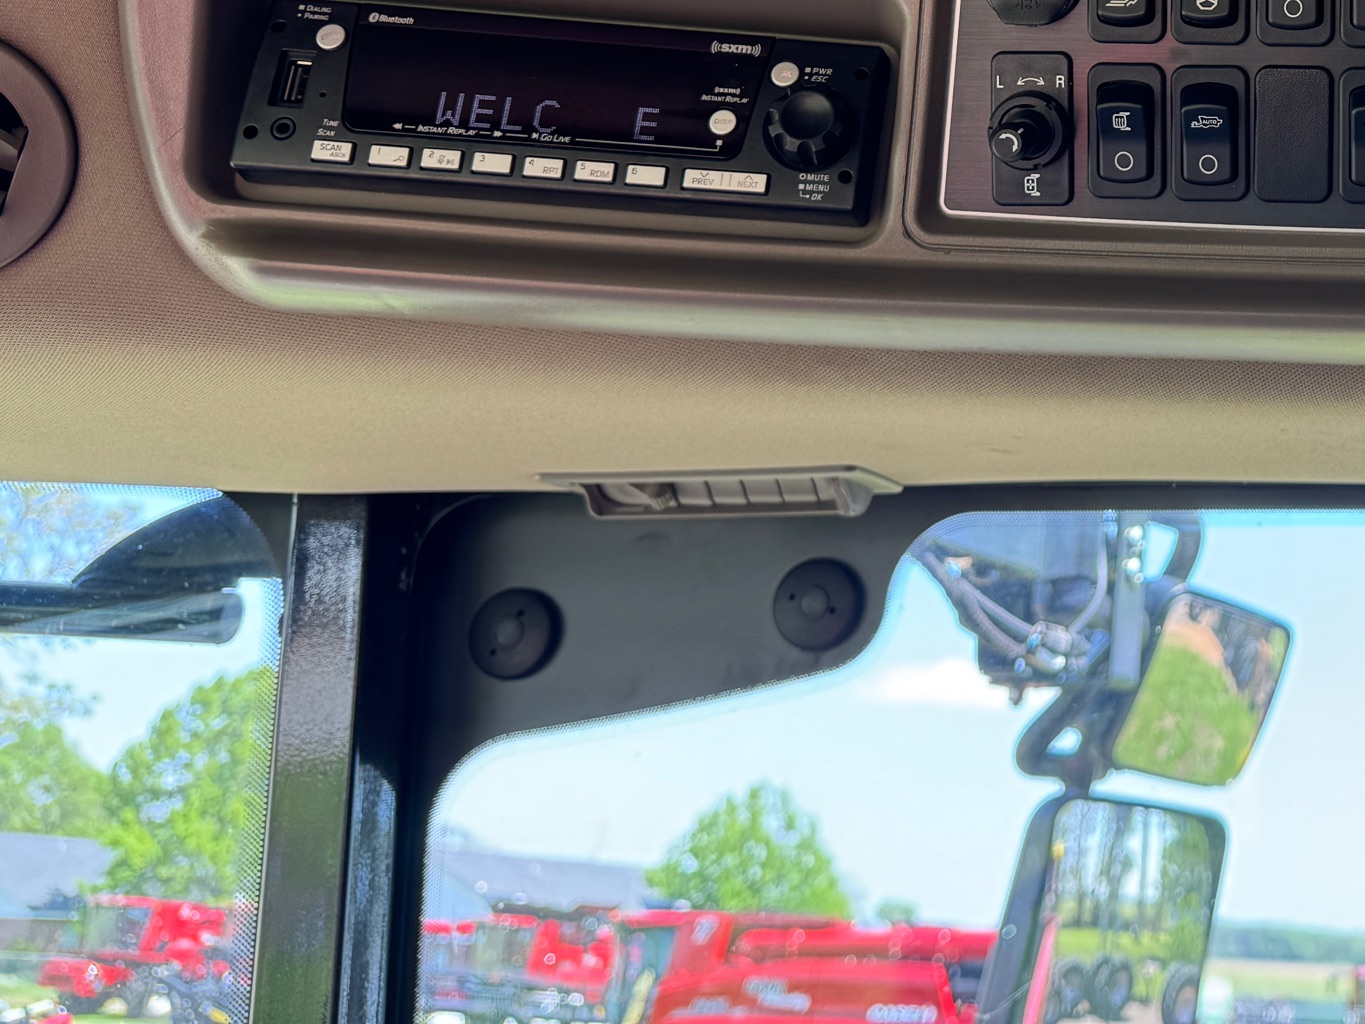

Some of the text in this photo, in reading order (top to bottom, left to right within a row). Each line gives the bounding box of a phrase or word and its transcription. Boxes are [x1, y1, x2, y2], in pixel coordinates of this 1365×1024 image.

[306, 5, 332, 13] DIALING
[304, 13, 329, 21] PAIRING
[379, 14, 414, 24] Bluetooth
[812, 67, 833, 75] PWR
[811, 75, 828, 83] ESC
[996, 74, 1004, 88] L
[1056, 75, 1065, 88] R
[701, 94, 749, 104] INSTANT REPLAY
[435, 91, 660, 141] WELC E
[323, 119, 339, 127] TUNE
[317, 128, 336, 136] SCAN
[416, 124, 478, 136] INSTANT REPLAY
[553, 135, 571, 143] LIVE
[320, 143, 342, 151] SCAN
[543, 167, 559, 175] RPT
[590, 169, 610, 178] RDM
[807, 173, 829, 181] MUTE
[692, 177, 715, 186] PREV
[737, 180, 759, 188] NEXT
[806, 183, 829, 192] MENU
